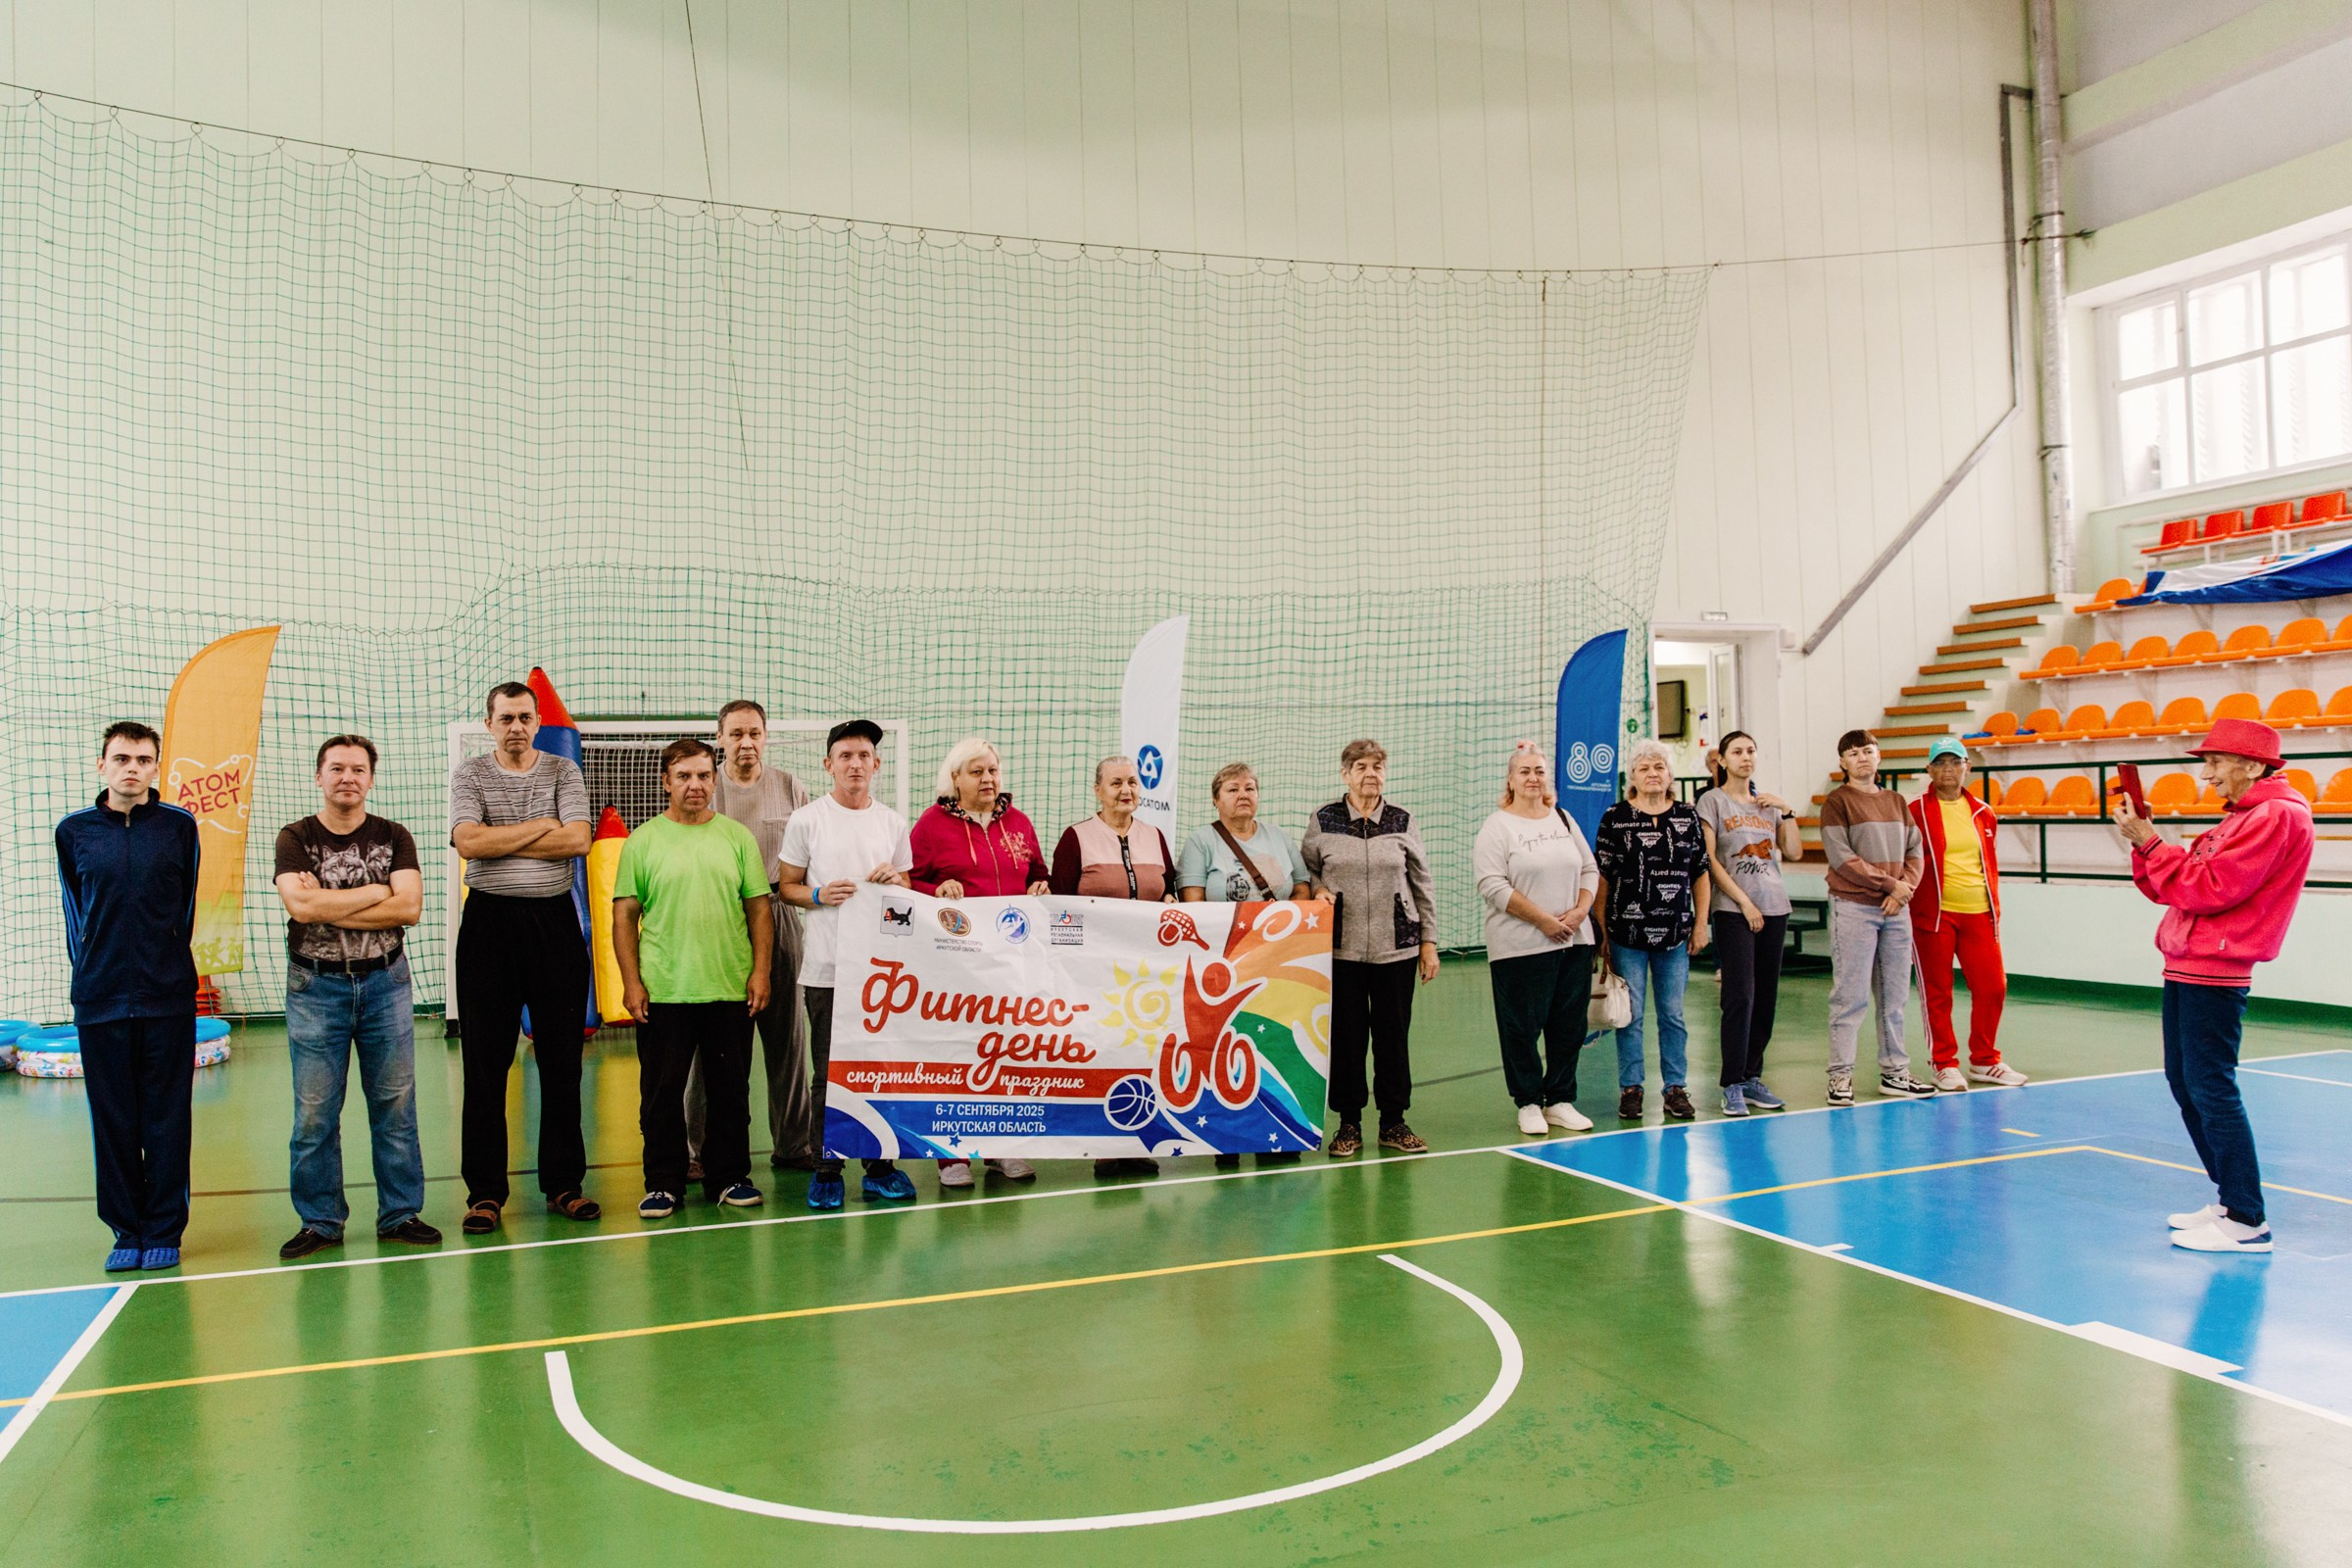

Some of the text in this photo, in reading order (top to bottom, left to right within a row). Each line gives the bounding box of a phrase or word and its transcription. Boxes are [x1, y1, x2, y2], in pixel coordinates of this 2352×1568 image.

[177, 769, 241, 802] АТОМ
[182, 787, 241, 815] ФЕСТ
[1138, 796, 1171, 812] ОСАТОМ
[861, 956, 1090, 1034] Фитнес-
[973, 1031, 1097, 1086] день
[846, 1062, 1085, 1096] спортивный праздник
[935, 1103, 1045, 1117] 6-7 СЕНТЯБРЯ 2025
[932, 1120, 1047, 1133] ИРКУТСКАЯ ОБЛАСТЬ
